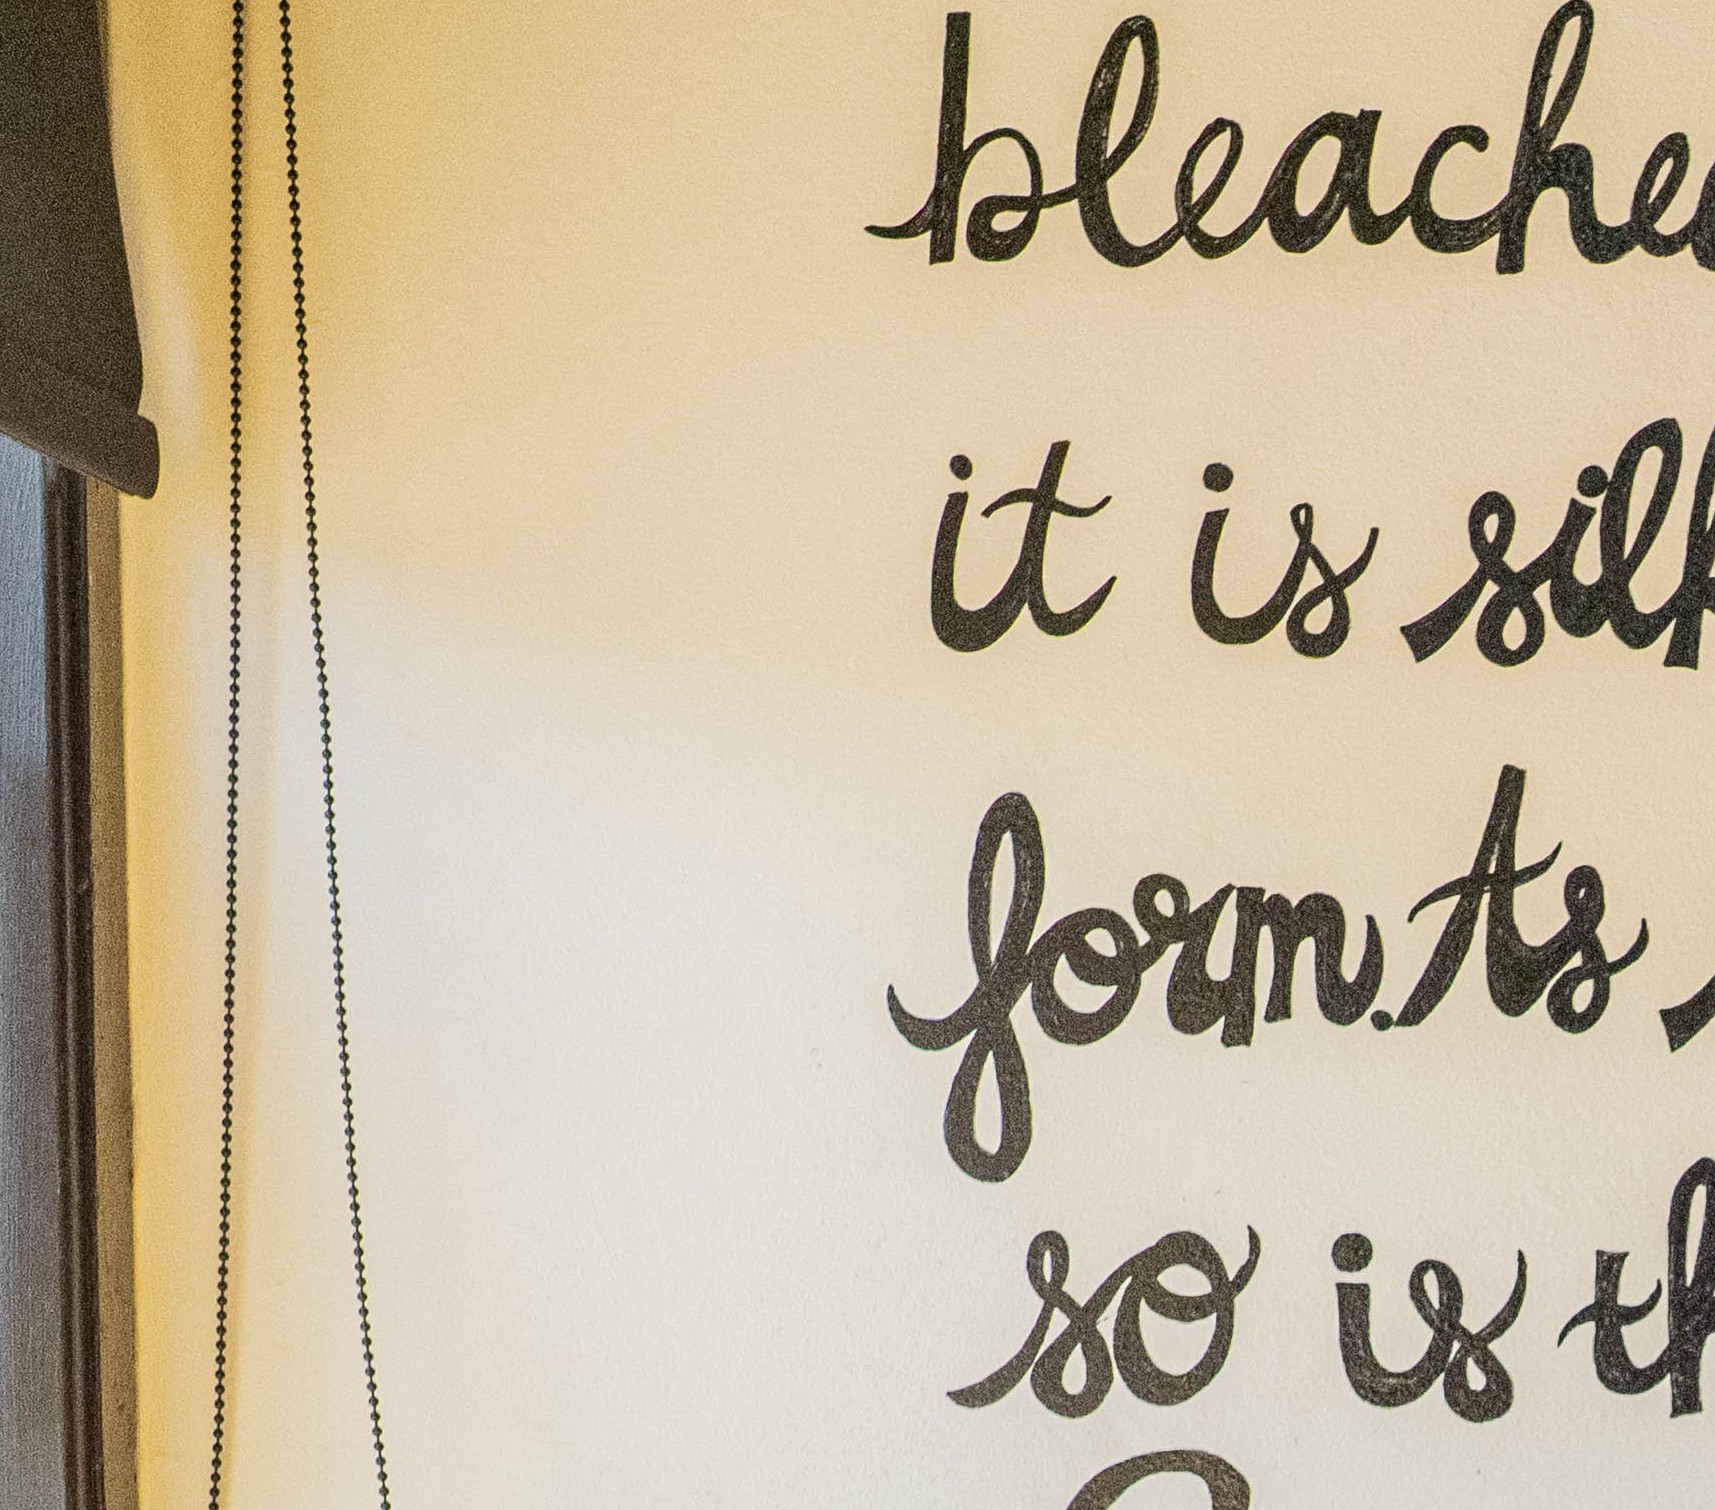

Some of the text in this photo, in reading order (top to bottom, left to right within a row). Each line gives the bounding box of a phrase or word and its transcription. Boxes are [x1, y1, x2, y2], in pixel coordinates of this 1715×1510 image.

[931, 440, 1117, 653] it
[1190, 461, 1380, 658] is
[1394, 763, 1649, 1034] As
[945, 1229, 1262, 1418] so
[1330, 1232, 1528, 1424] is
